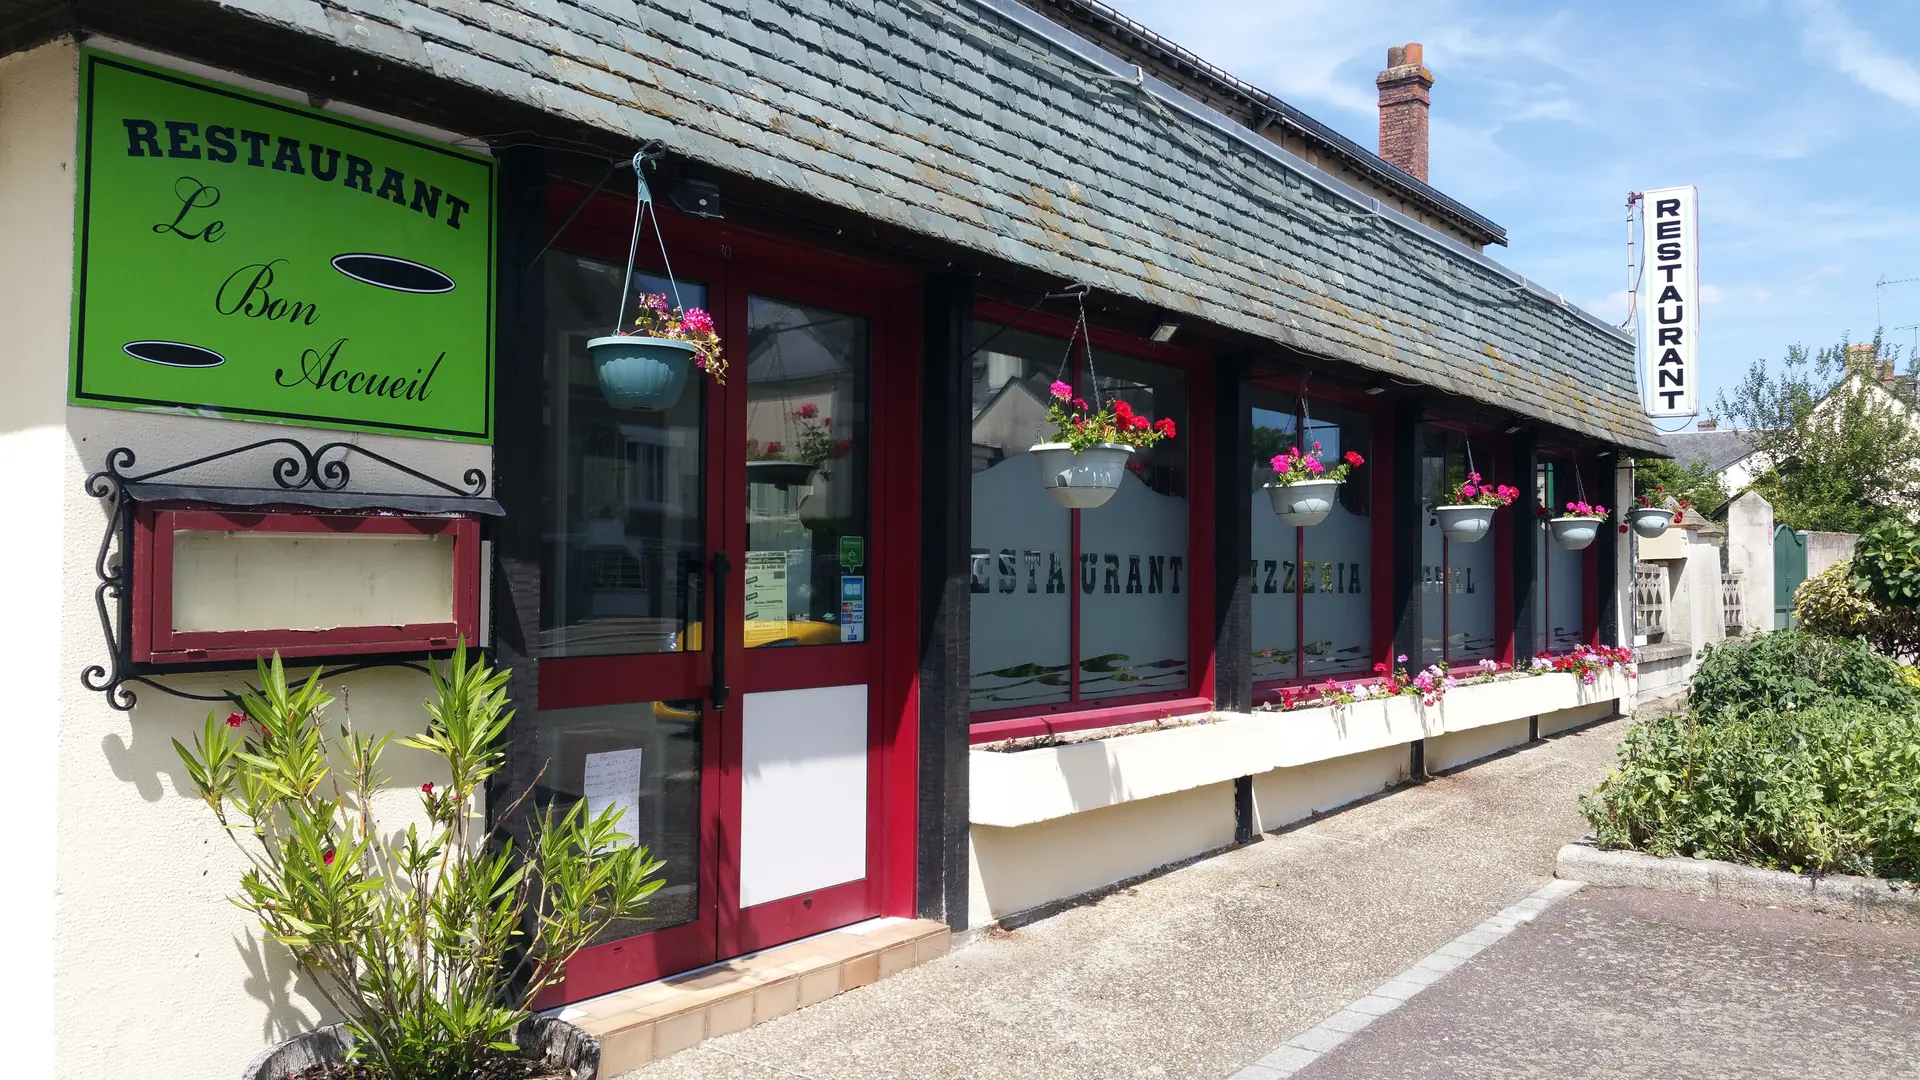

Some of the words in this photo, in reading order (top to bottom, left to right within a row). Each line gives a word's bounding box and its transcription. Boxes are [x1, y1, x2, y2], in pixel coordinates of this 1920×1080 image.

[123, 118, 470, 230] RESTAURANT
[152, 176, 226, 243] Le
[215, 258, 321, 325] Bon
[1656, 198, 1684, 410] RESTAURANT
[275, 337, 446, 401] Accueil
